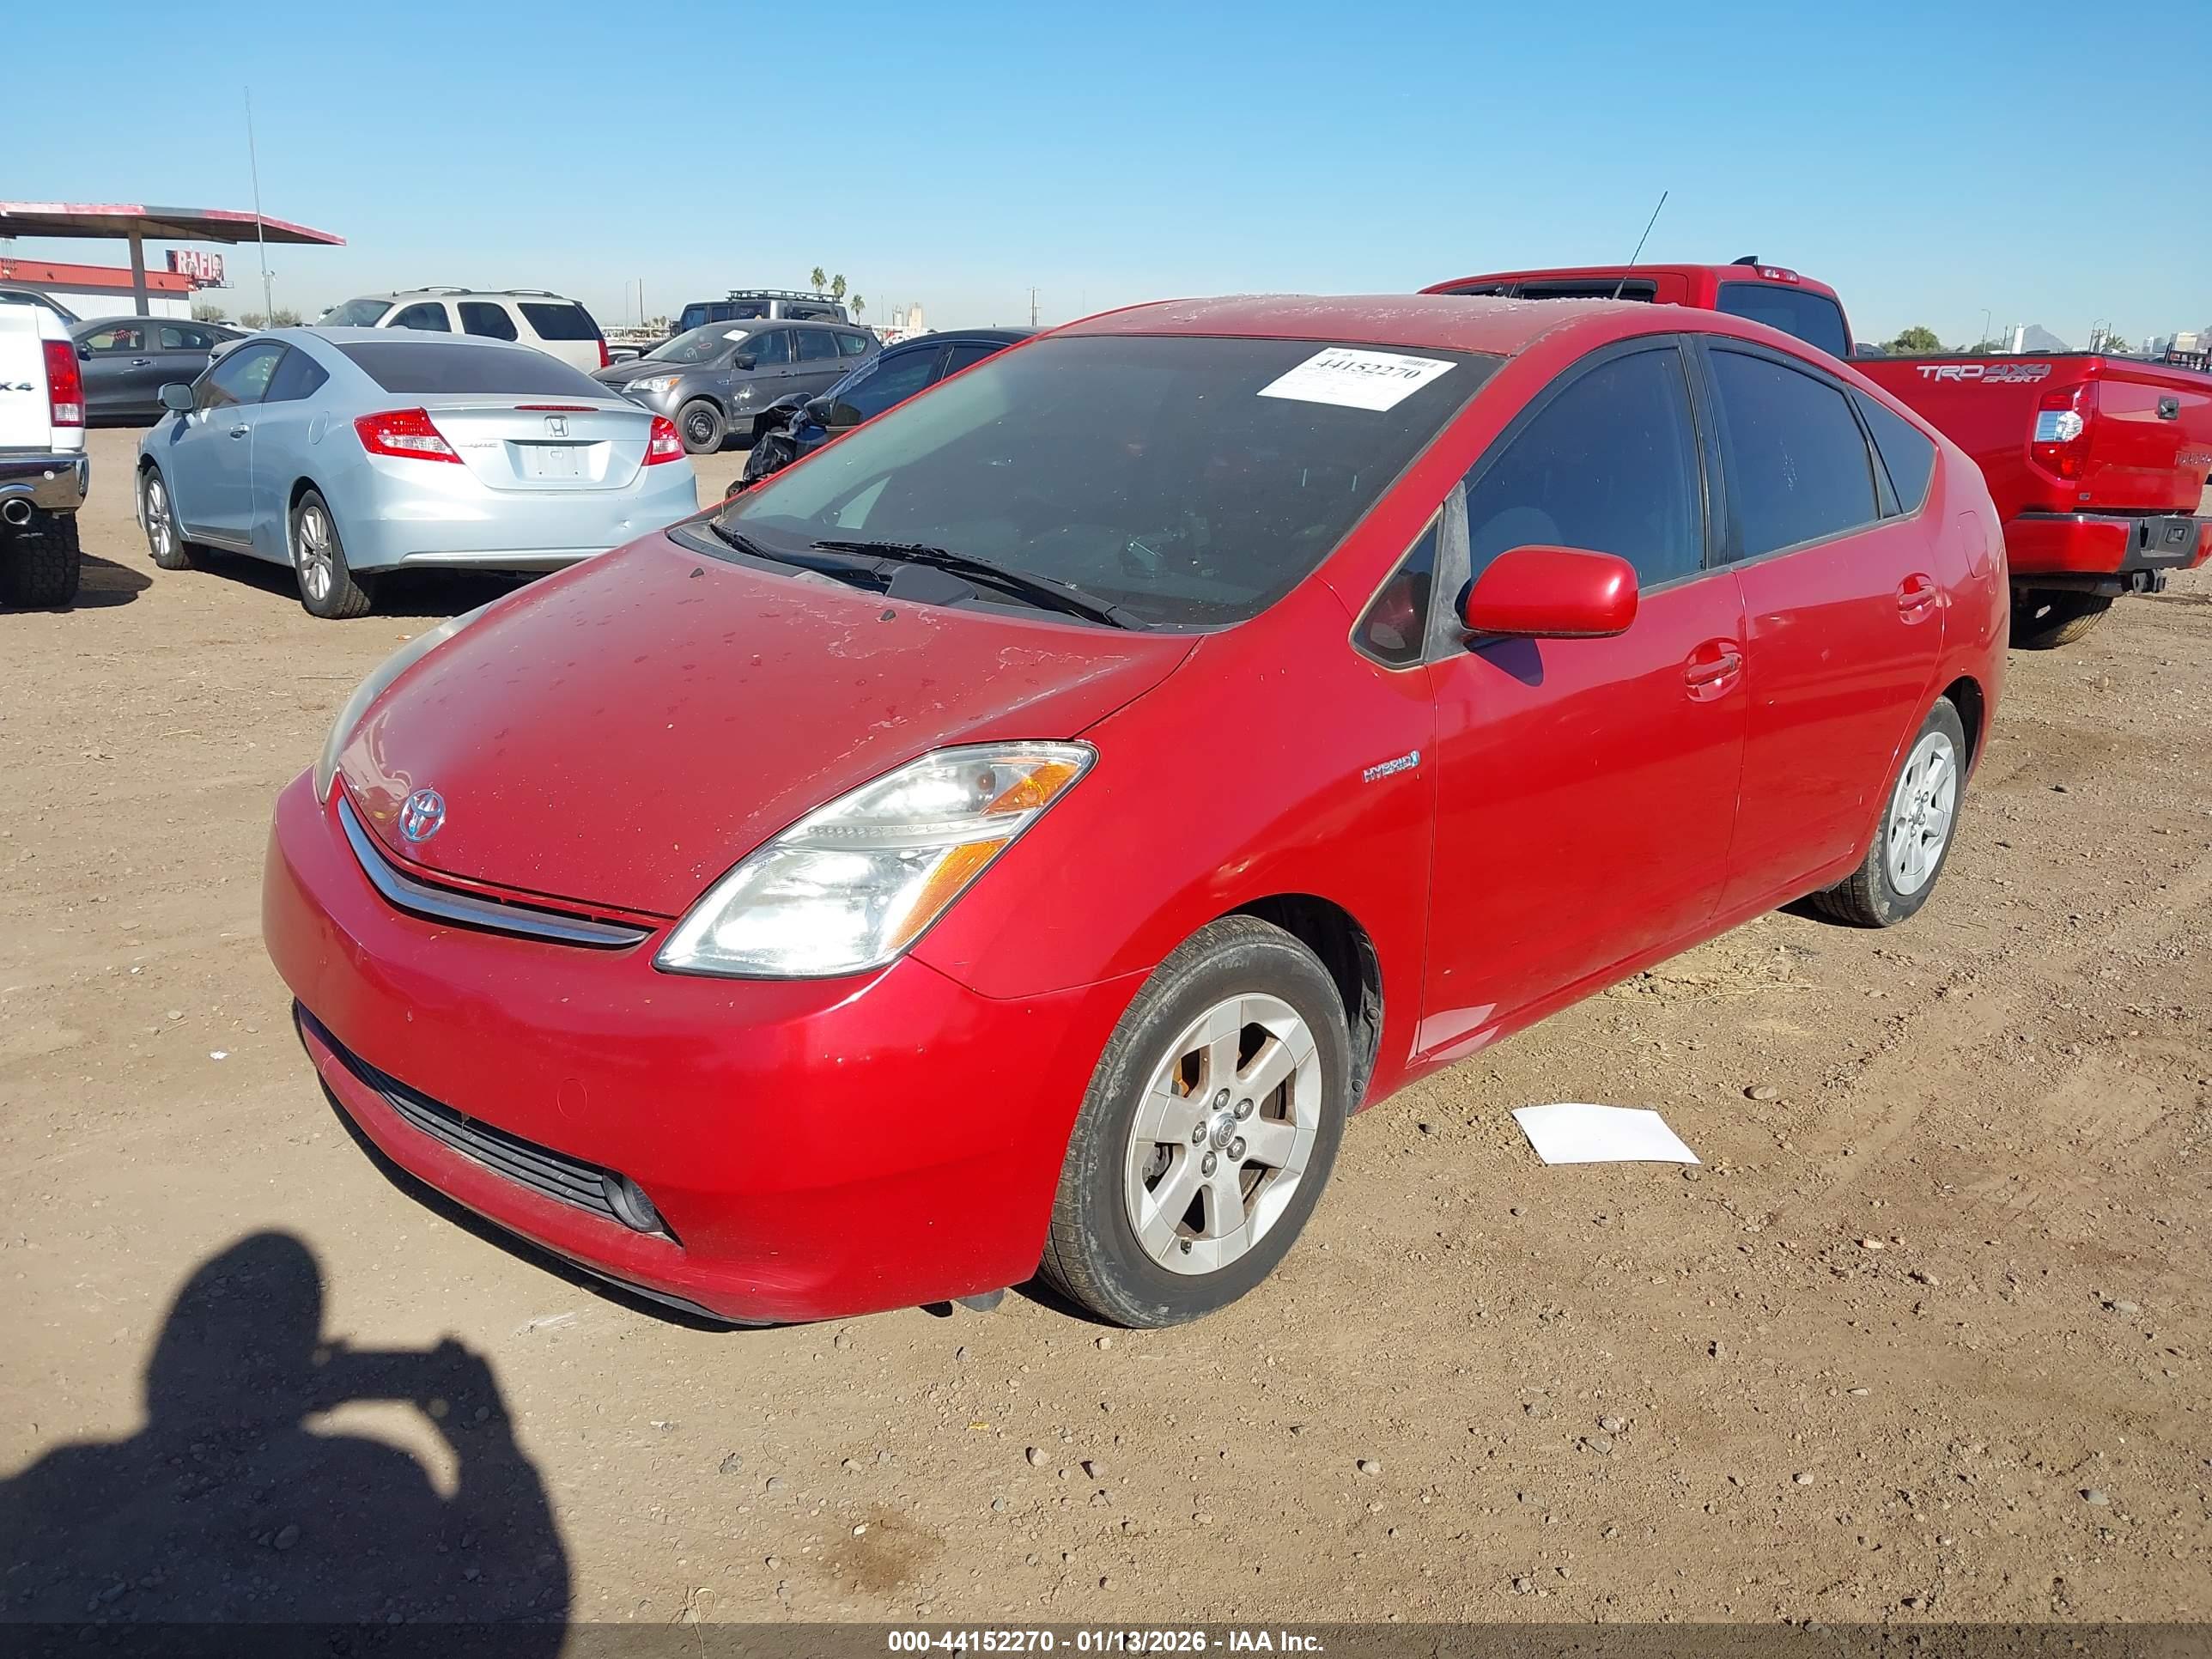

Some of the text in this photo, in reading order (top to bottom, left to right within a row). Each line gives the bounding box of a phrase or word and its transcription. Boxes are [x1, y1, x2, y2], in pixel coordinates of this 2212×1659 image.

[1316, 359, 1421, 380] 44152270
[1917, 364, 2051, 382] TRD 4X4
[1363, 755, 1412, 783] HYBRID
